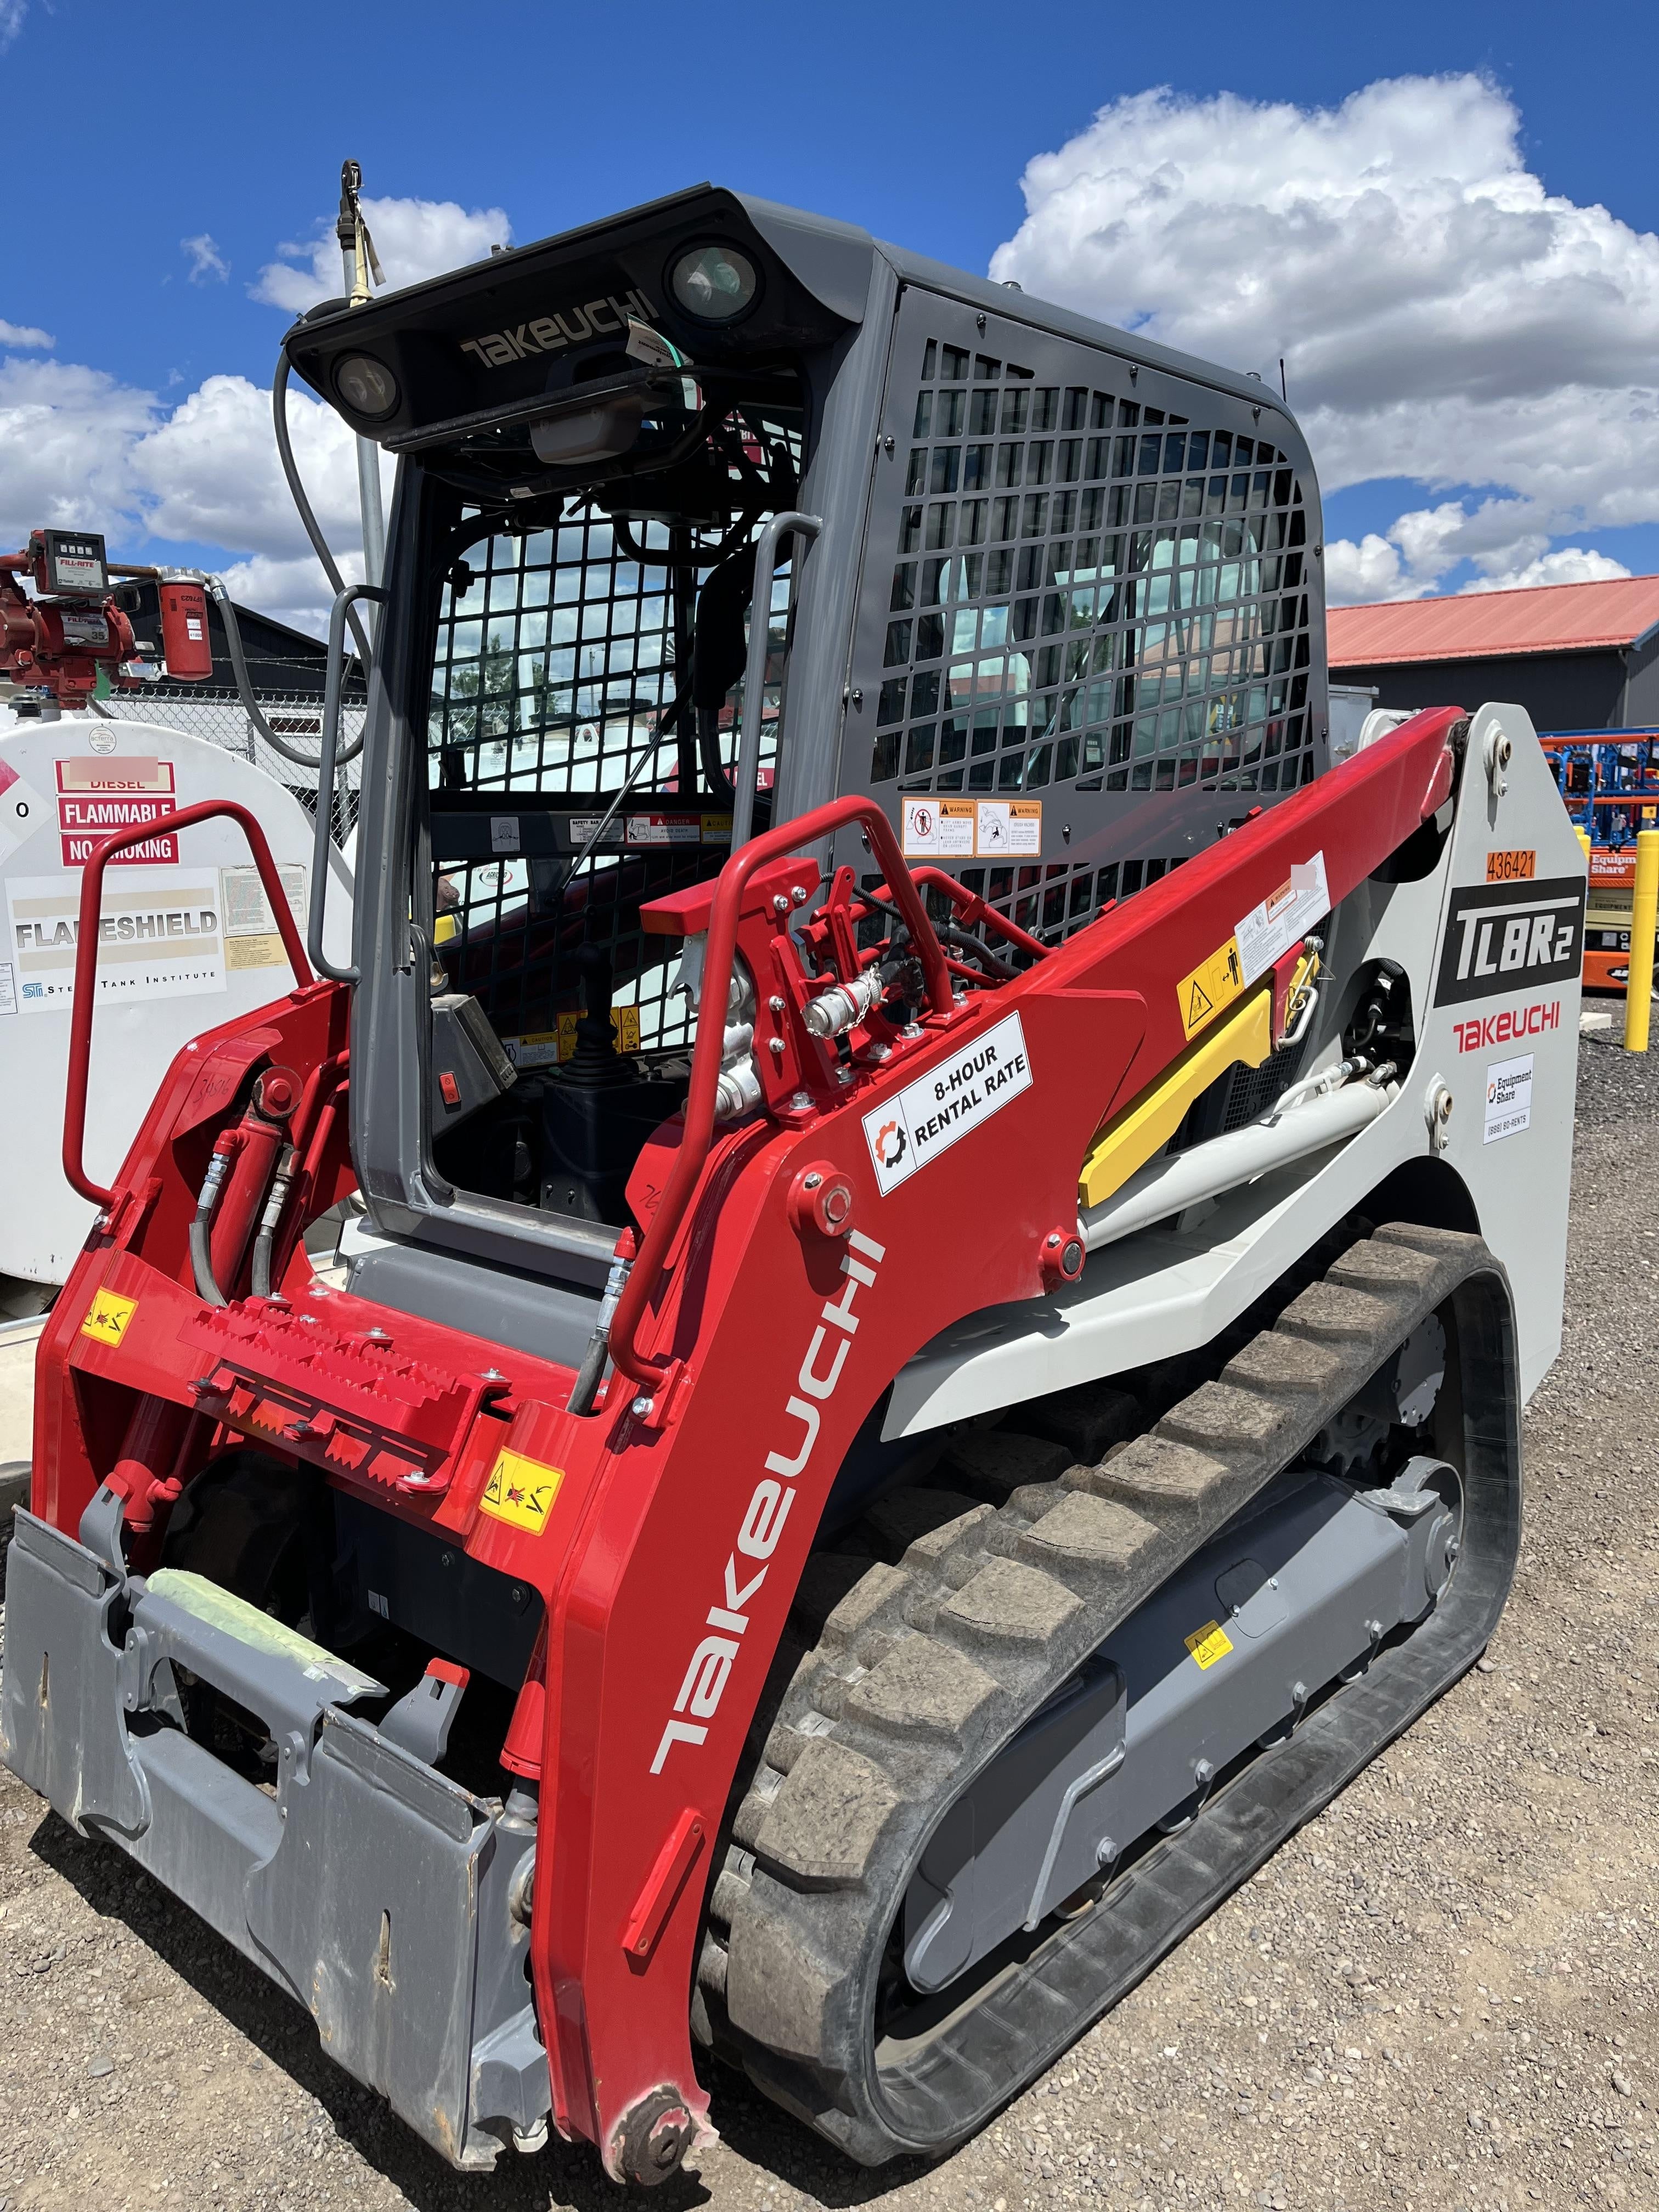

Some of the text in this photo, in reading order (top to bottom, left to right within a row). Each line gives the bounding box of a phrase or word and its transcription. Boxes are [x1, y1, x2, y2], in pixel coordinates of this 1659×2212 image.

[60, 559, 94, 568] FILL-RITE
[70, 840, 93, 860] NO
[1592, 854, 1637, 865] Equipm
[1487, 850, 1534, 880] 436421
[16, 911, 217, 949] FLAESHIELD
[1456, 896, 1580, 981] TL8R2
[145, 971, 216, 984] INSTITUTE
[933, 1046, 998, 1103] 8-HOUR
[1497, 1069, 1532, 1091] Equipment
[915, 1053, 1027, 1147] RENTAL RATE
[1497, 1090, 1516, 1104] Share
